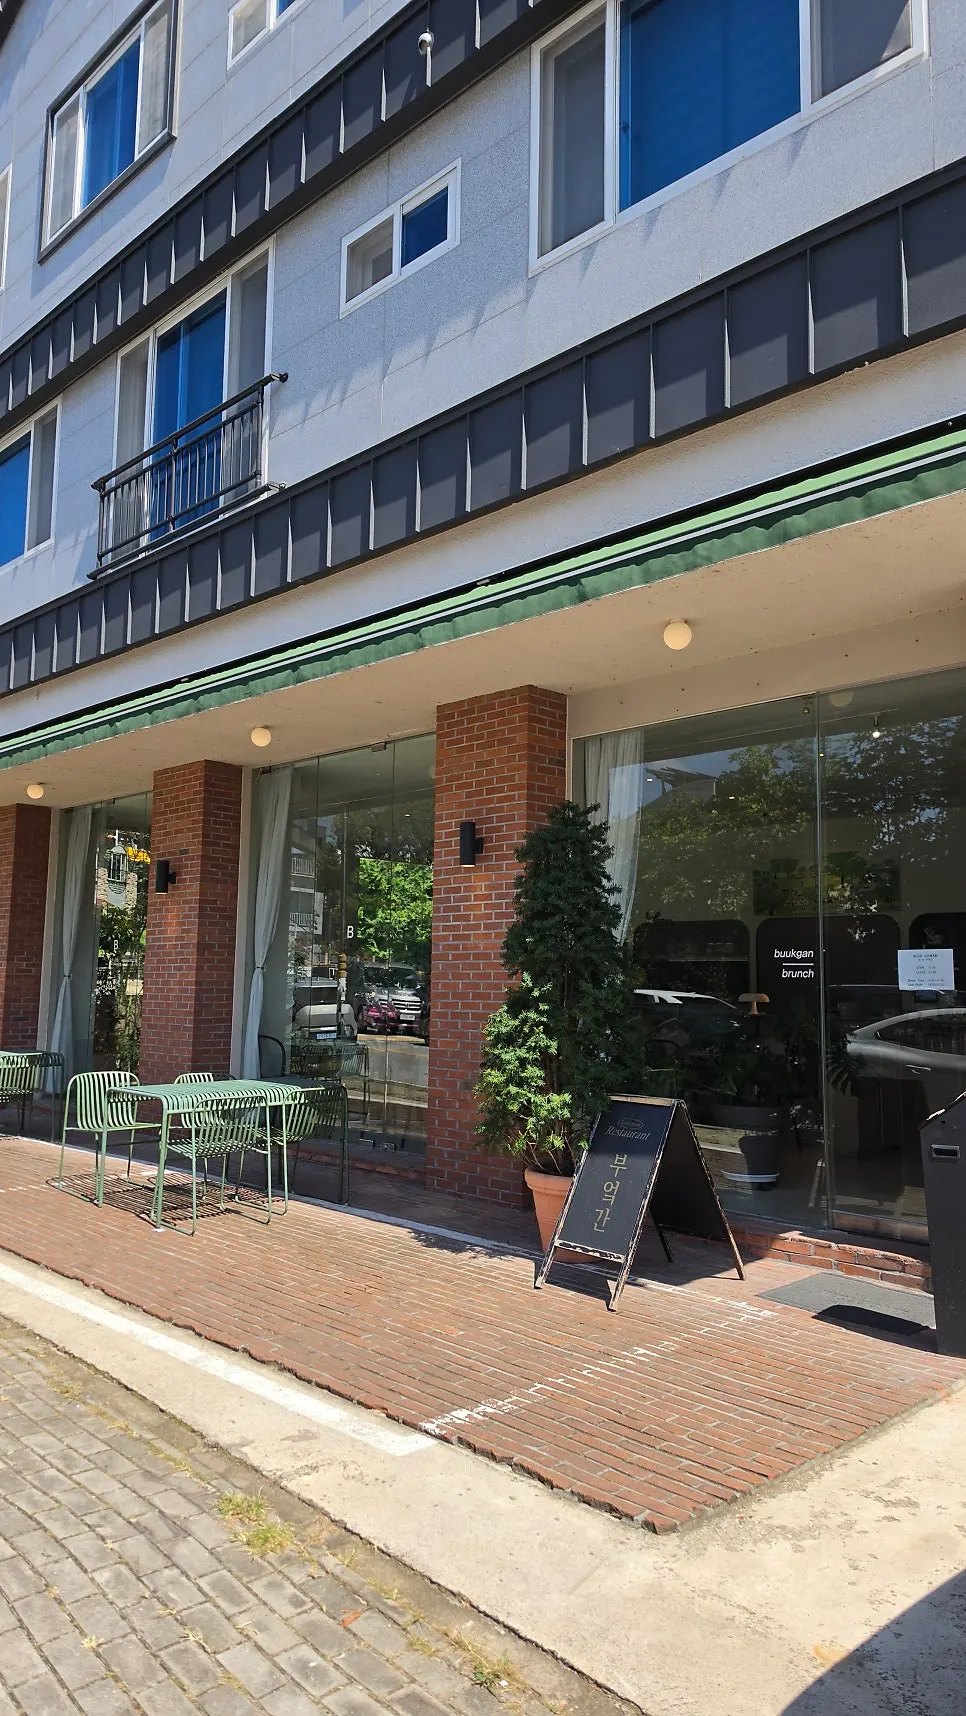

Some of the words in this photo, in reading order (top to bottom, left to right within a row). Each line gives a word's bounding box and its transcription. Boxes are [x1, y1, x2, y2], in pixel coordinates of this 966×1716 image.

[773, 948, 814, 960] buukgan
[781, 968, 815, 979] brunch
[604, 1125, 651, 1141] Restaurant
[593, 1153, 628, 1233] 부엌간
